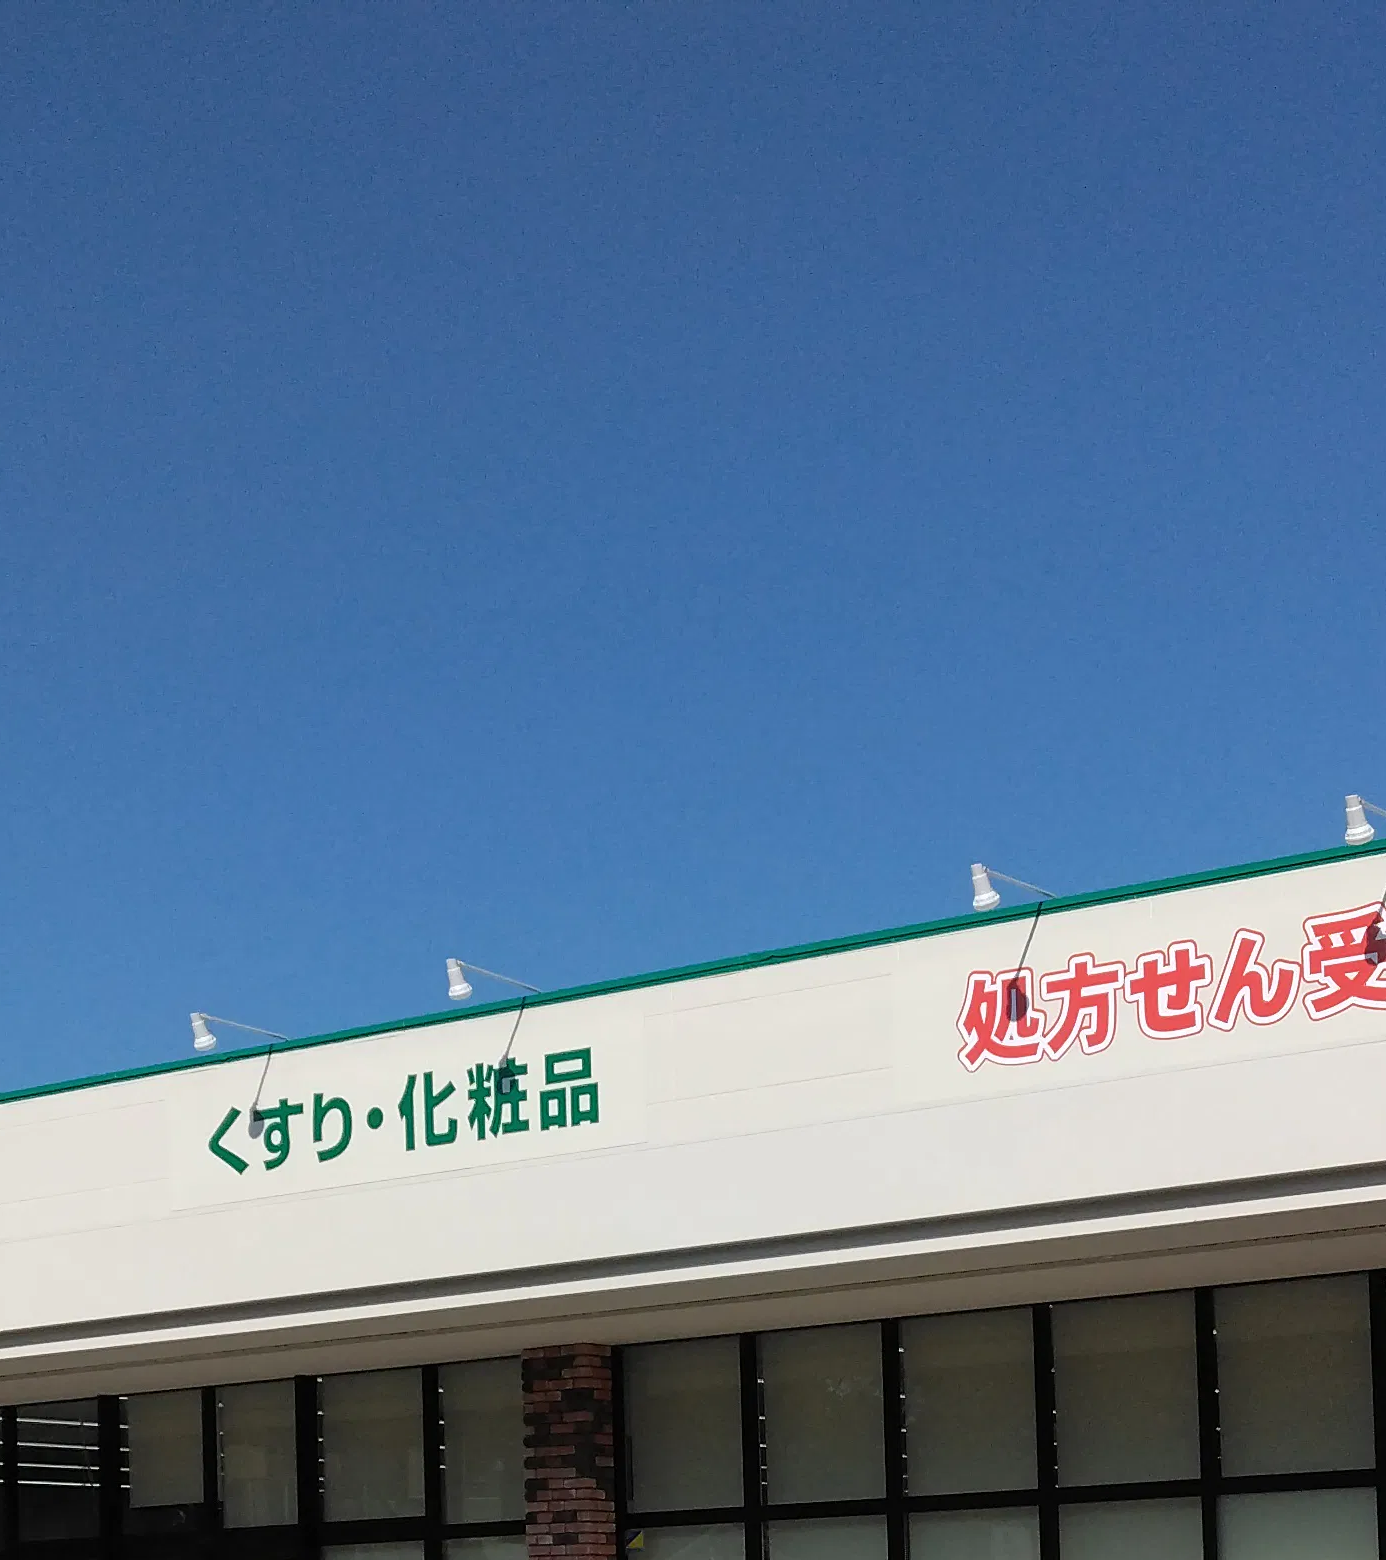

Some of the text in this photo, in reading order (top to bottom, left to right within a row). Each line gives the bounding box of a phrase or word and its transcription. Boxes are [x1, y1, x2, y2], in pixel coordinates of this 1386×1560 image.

[207, 1045, 600, 1176] くすり・化粧品
